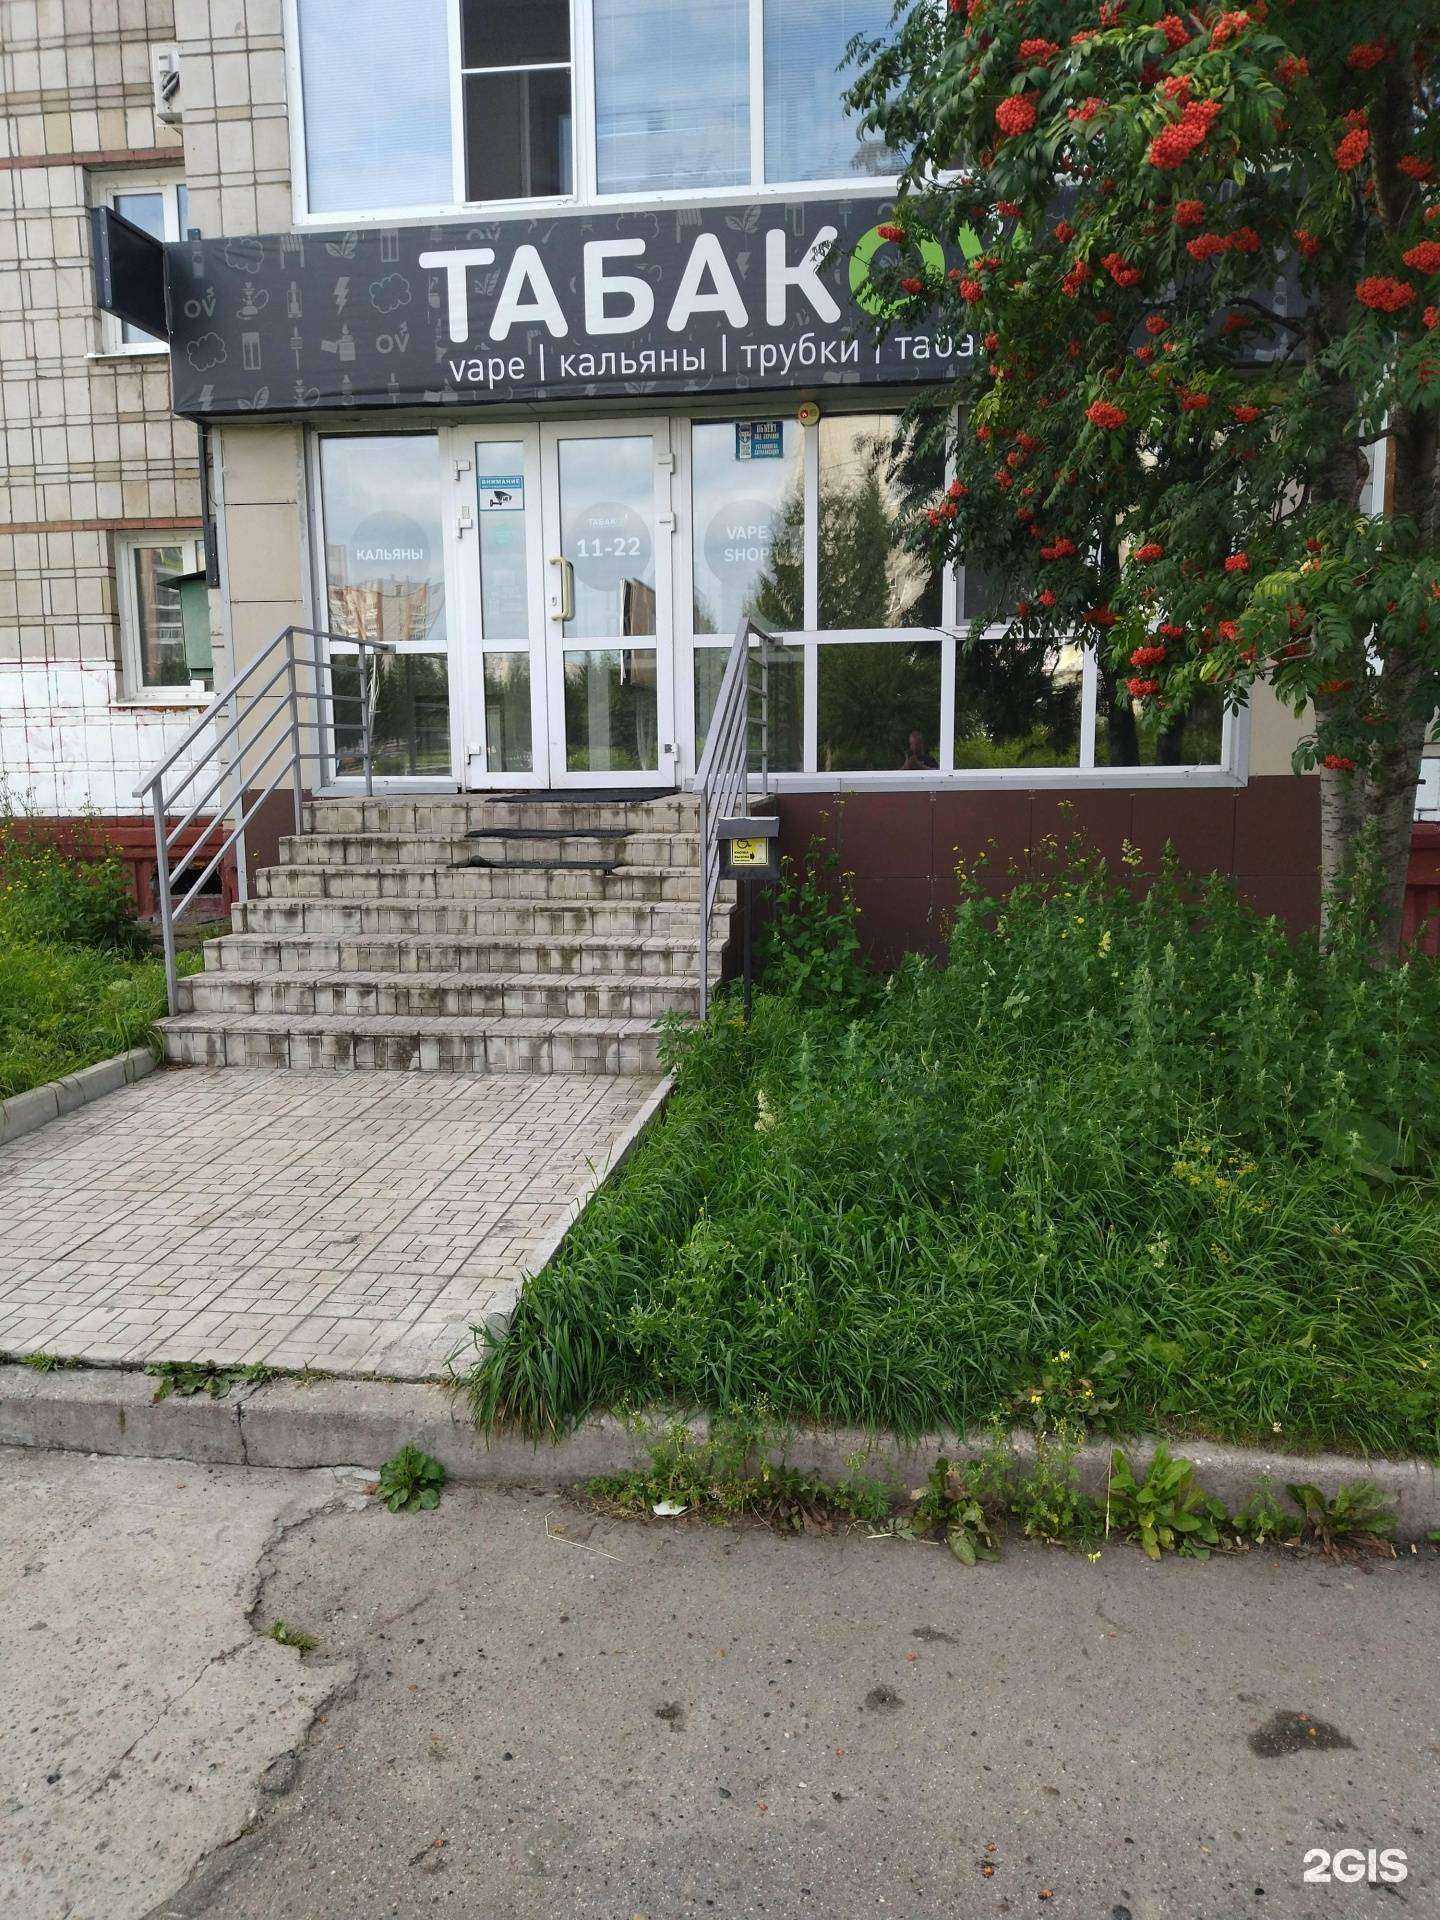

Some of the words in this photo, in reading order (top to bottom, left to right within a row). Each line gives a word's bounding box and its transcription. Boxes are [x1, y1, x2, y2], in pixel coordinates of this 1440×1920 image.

[449, 356, 526, 390] vape
[560, 347, 706, 378] кальяны
[740, 332, 860, 377] трубки
[481, 478, 520, 486] ВНИМАНИЕ
[726, 525, 769, 540] VAPE
[576, 536, 641, 557] 11-22
[356, 548, 424, 561] КАЛЬЯНЫ
[723, 547, 771, 562] SHOP
